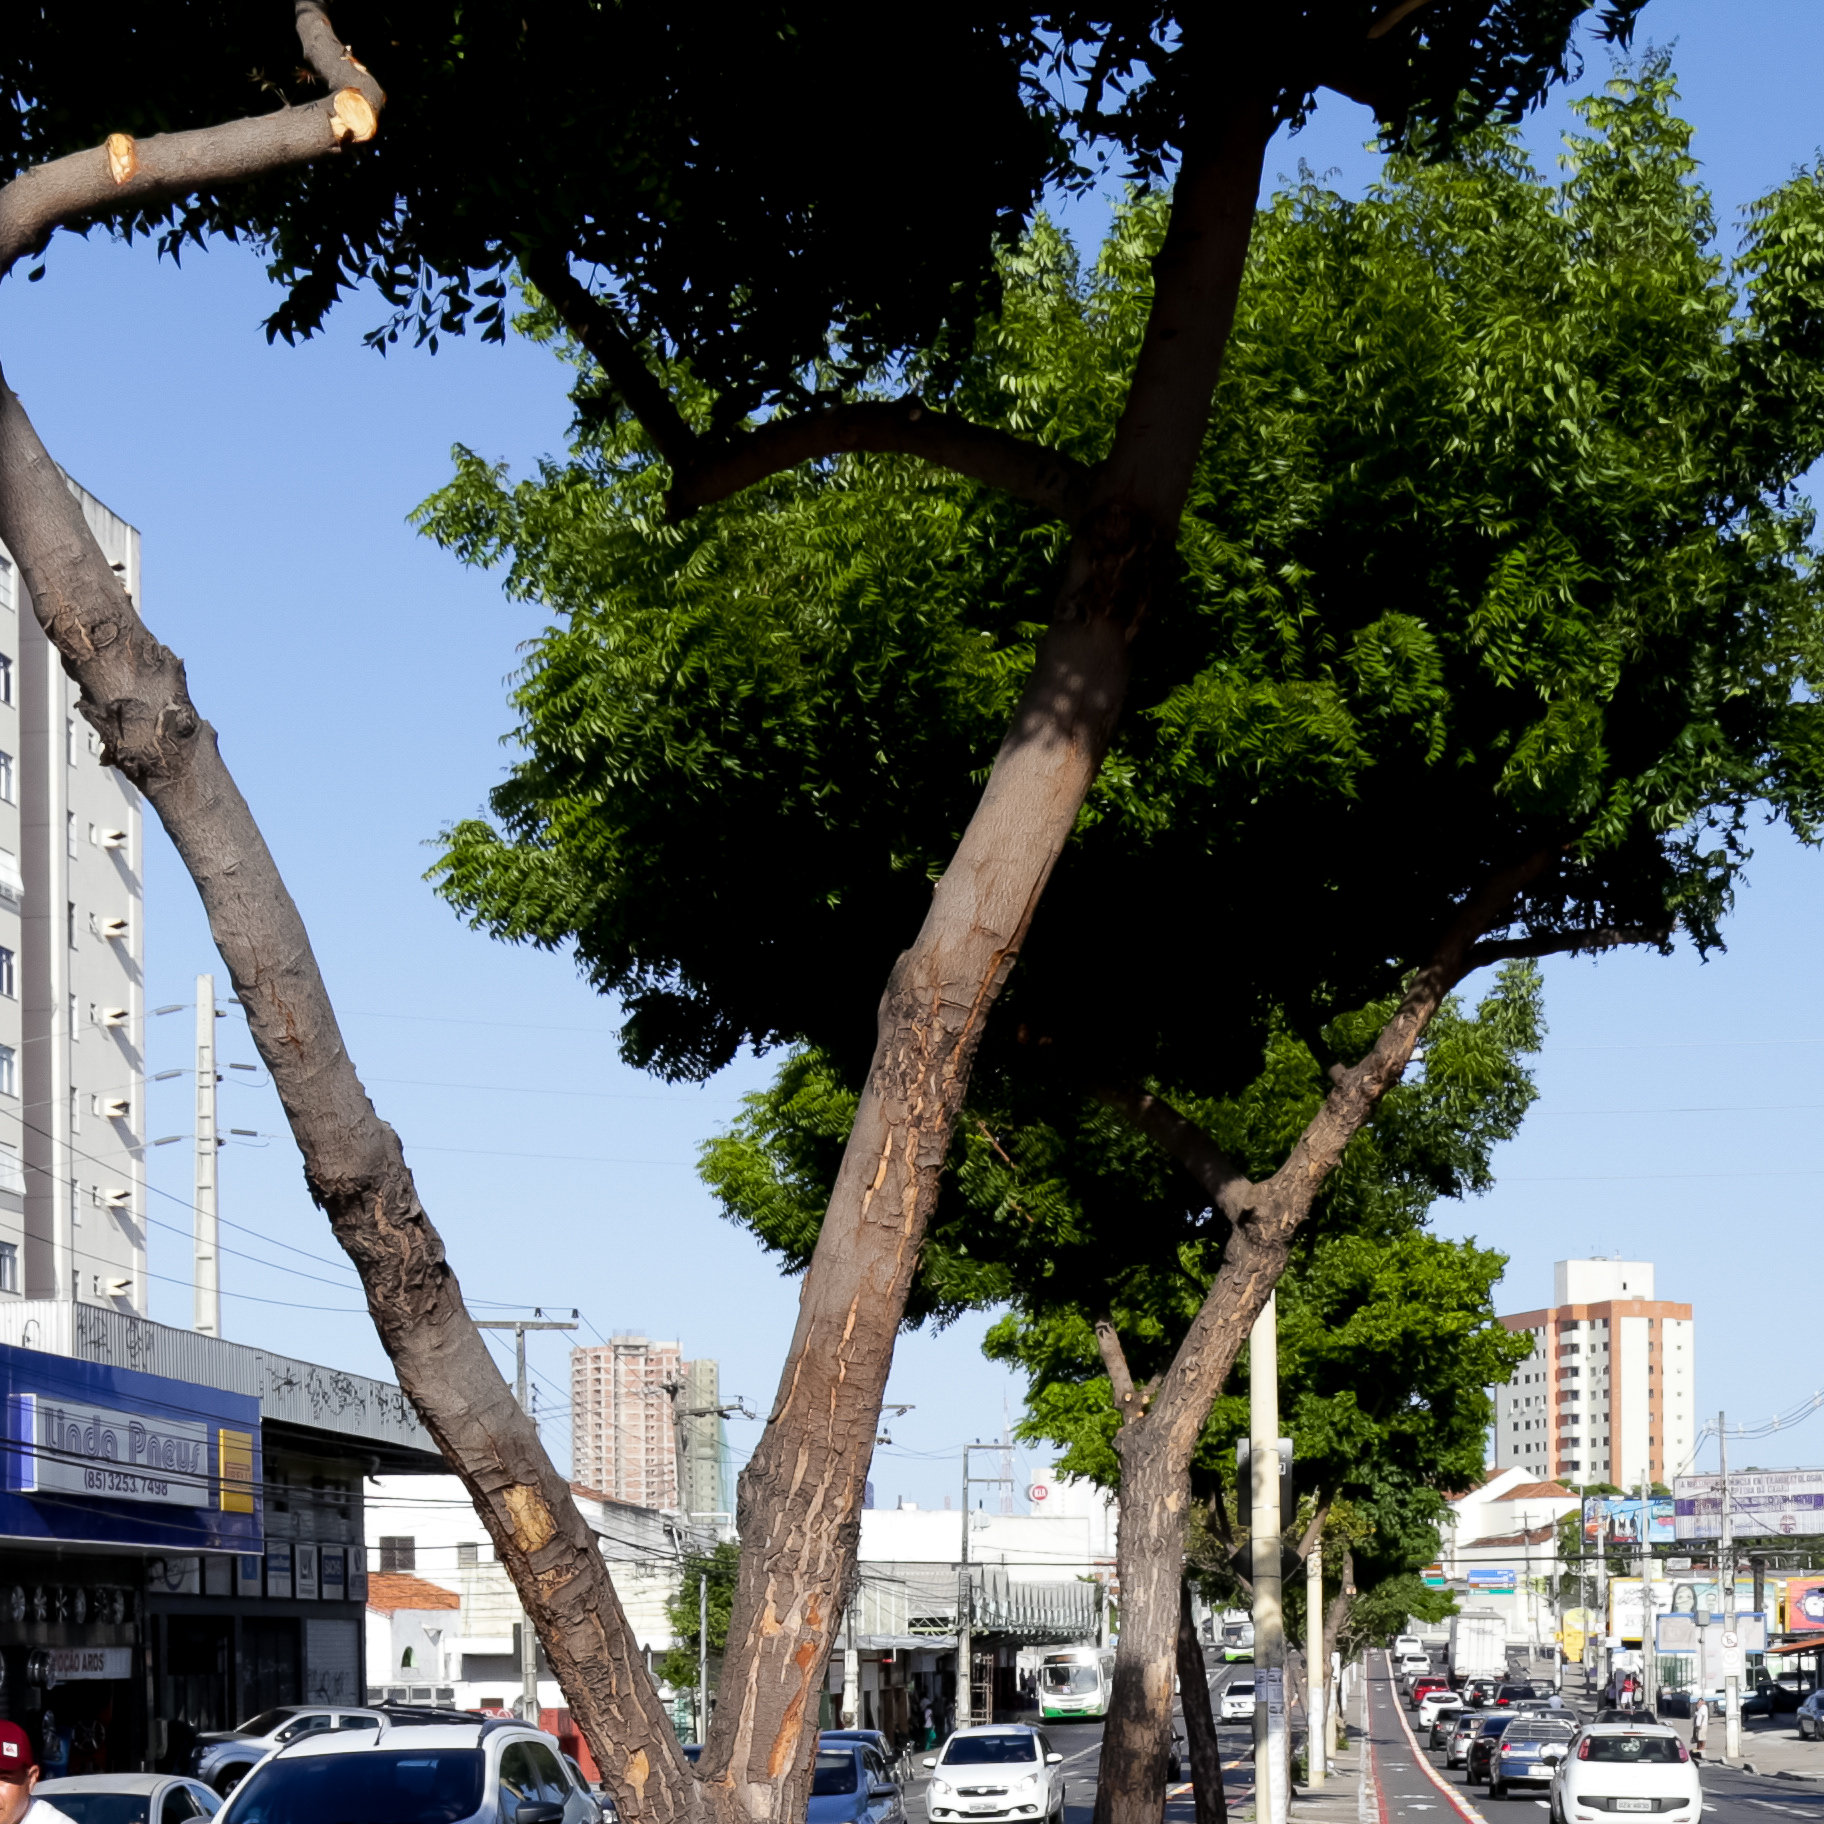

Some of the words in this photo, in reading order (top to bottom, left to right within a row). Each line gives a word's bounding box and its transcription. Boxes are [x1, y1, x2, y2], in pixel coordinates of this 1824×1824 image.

[44, 1407, 119, 1460] Linda
[128, 1420, 202, 1473] Pneus
[1034, 1488, 1046, 1498] KIA
[81, 1653, 105, 1672] AROS
